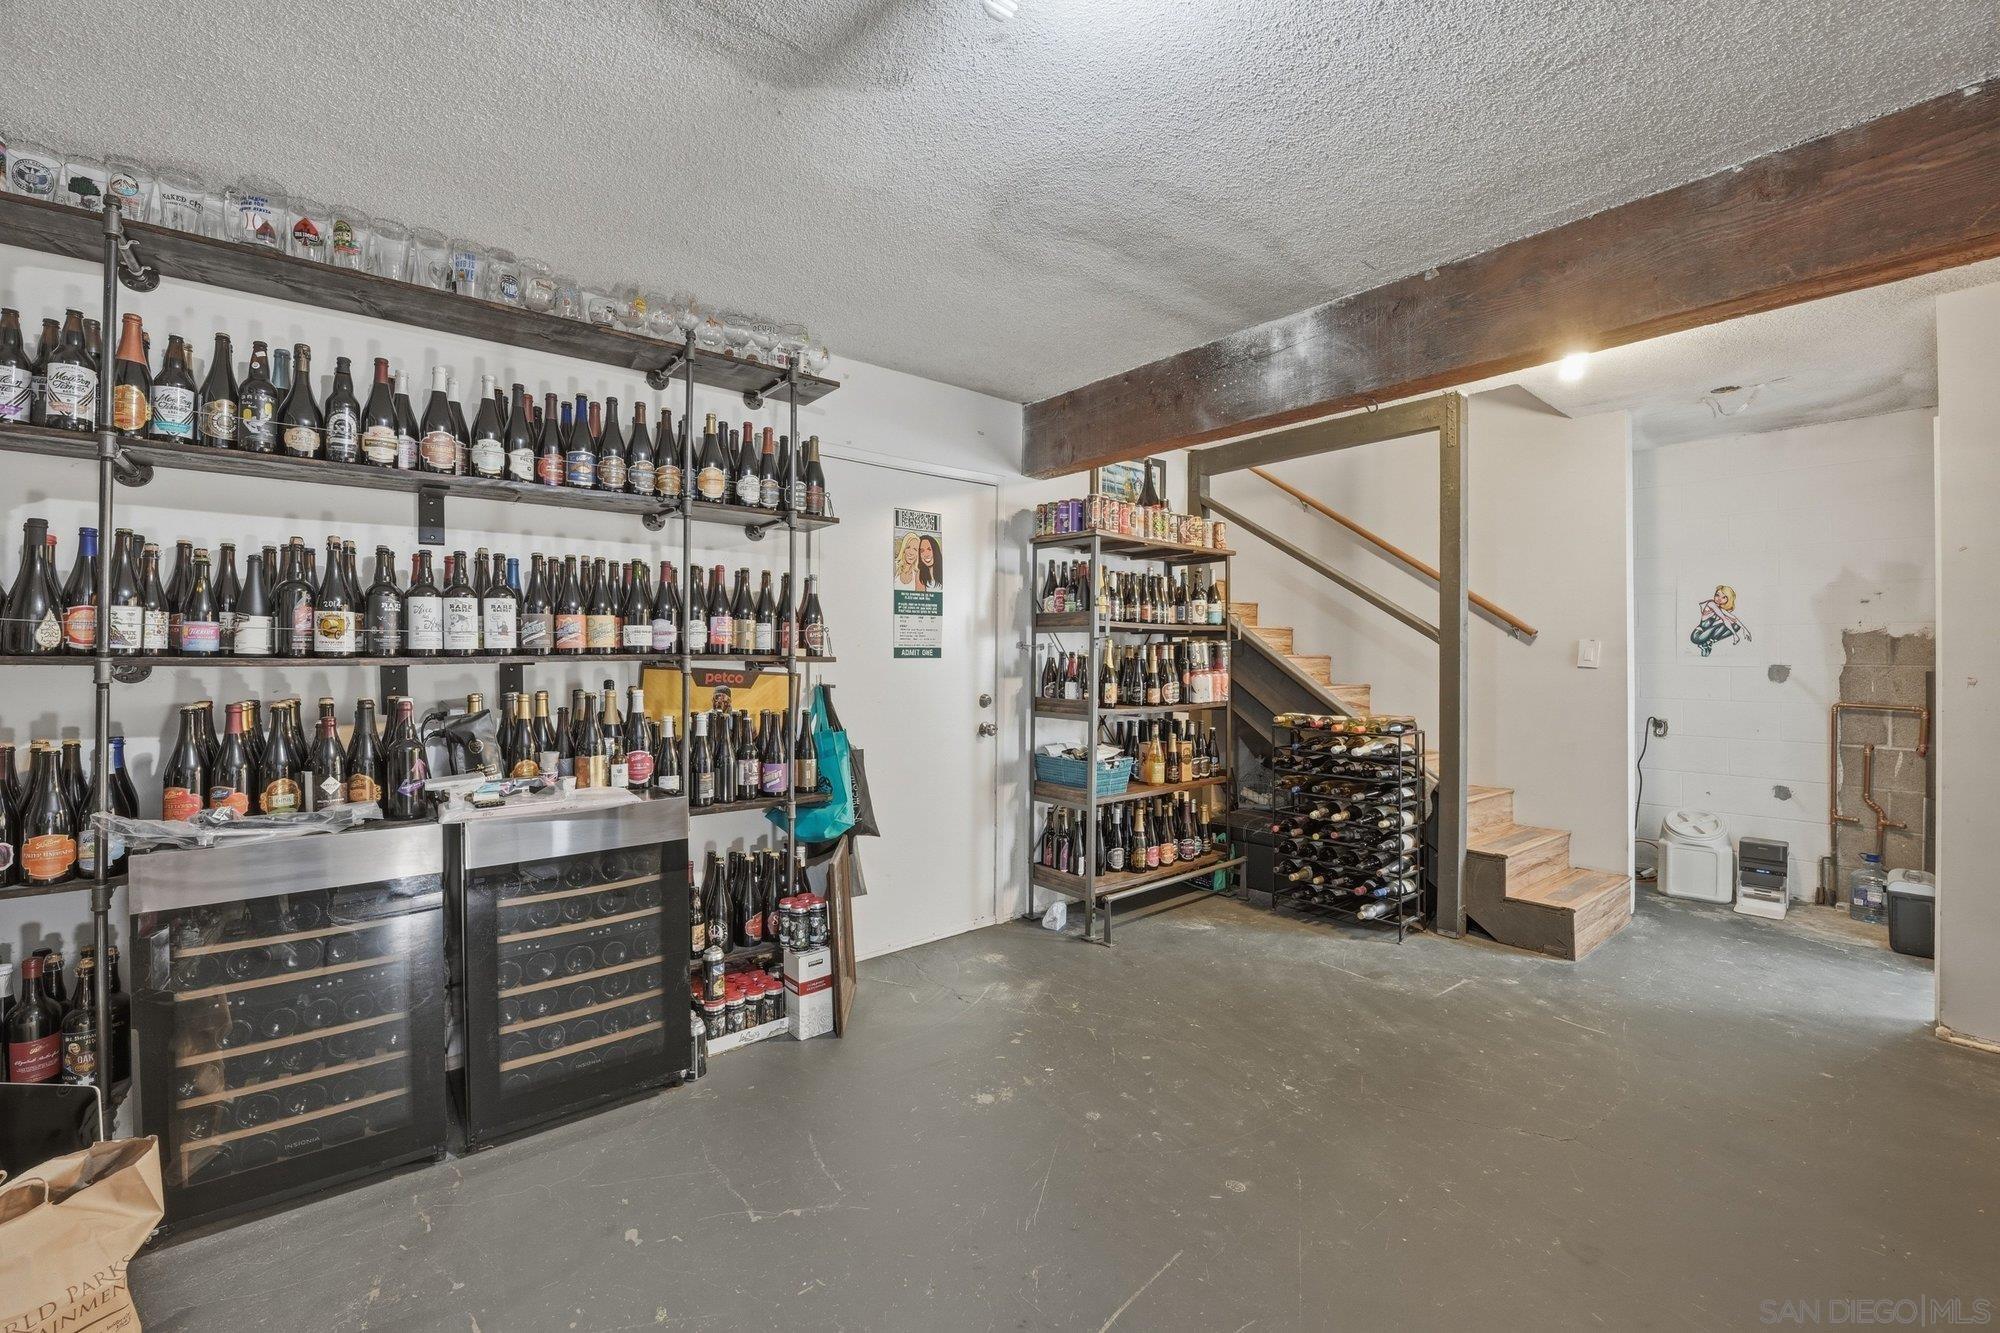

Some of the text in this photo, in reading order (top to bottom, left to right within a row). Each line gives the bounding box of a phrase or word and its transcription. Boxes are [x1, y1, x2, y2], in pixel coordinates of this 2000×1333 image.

[901, 648, 934, 657] ADMIT ONE
[704, 671, 744, 685] petco
[77, 1053, 94, 1064] OAK
